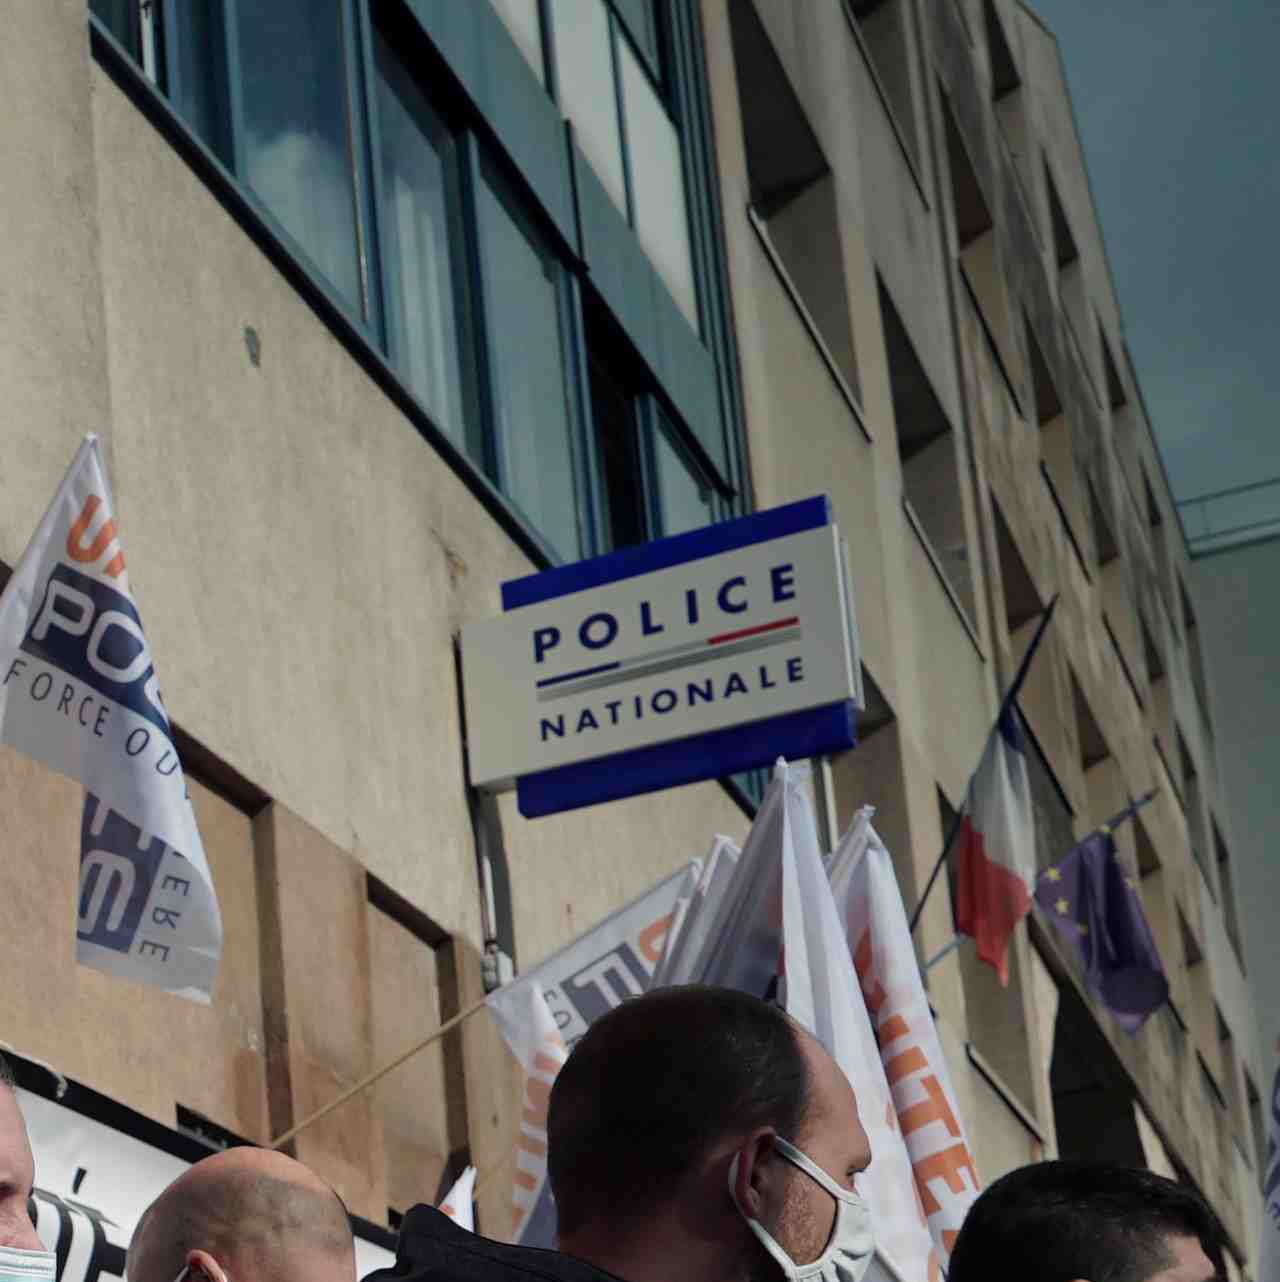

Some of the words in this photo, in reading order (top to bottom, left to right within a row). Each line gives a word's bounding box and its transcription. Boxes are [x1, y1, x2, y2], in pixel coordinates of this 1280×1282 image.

[532, 563, 796, 663] POLICE
[2, 659, 110, 738] FORCE
[540, 657, 804, 741] NATIONALE
